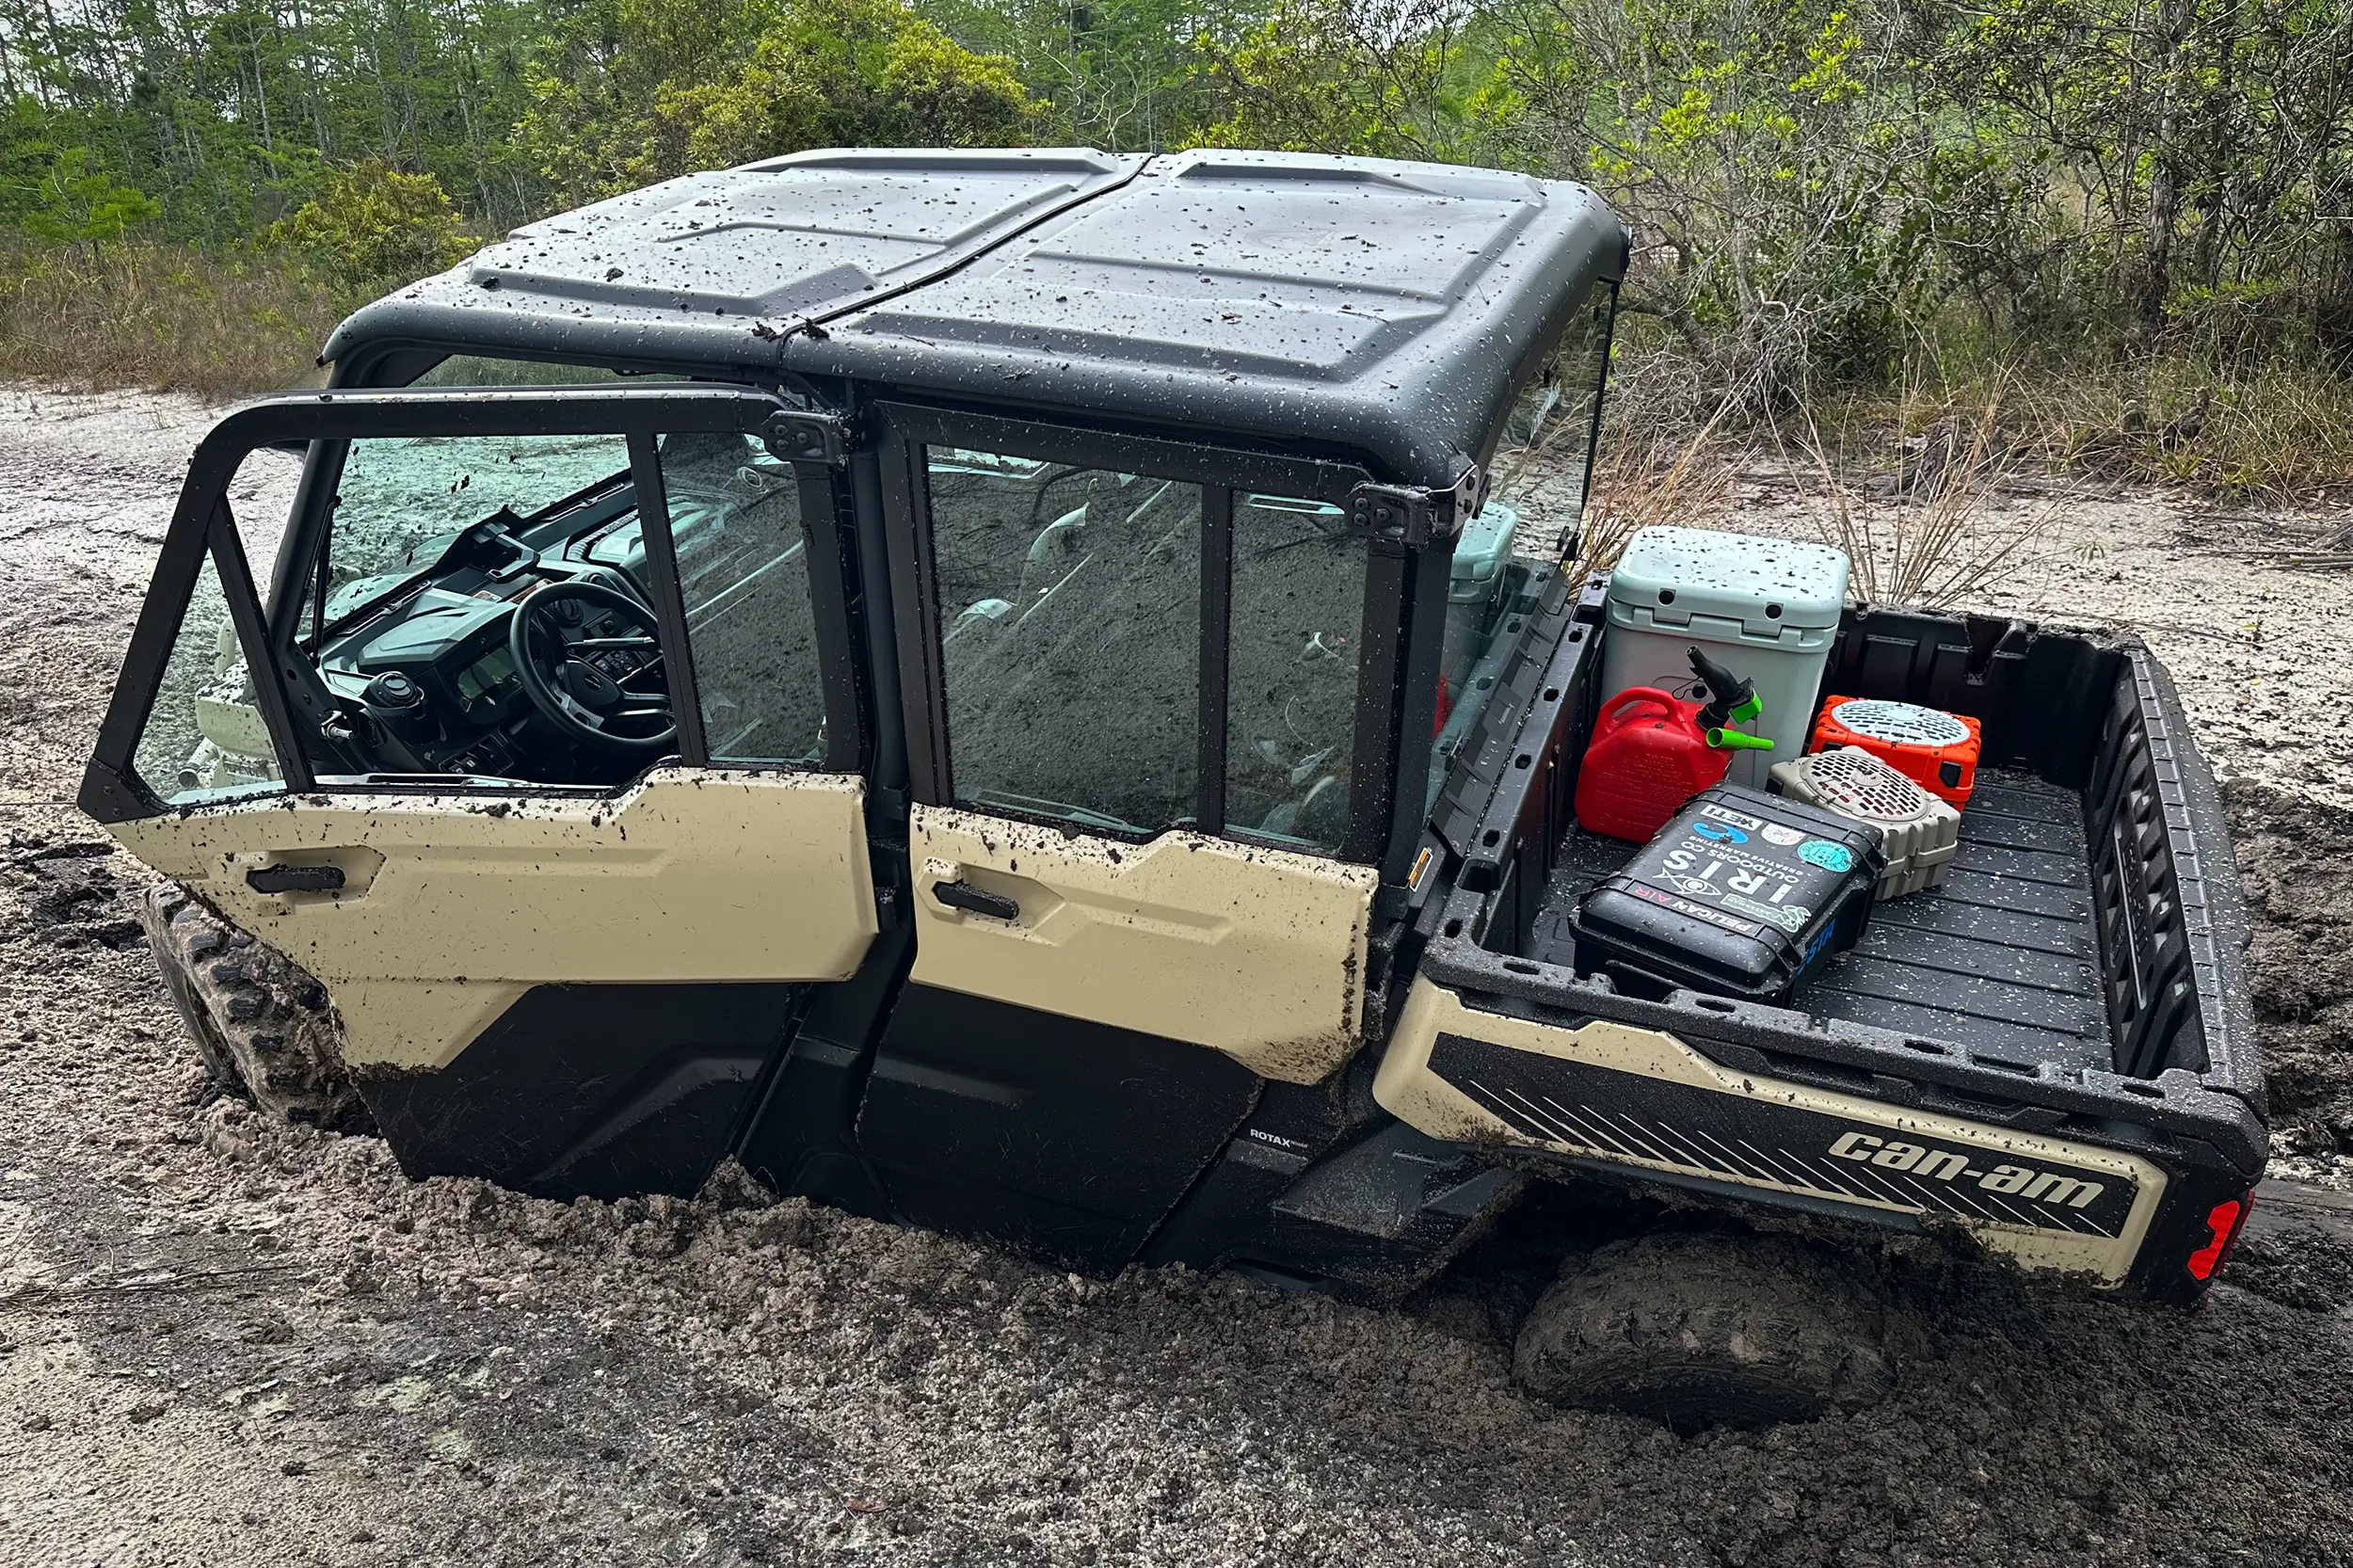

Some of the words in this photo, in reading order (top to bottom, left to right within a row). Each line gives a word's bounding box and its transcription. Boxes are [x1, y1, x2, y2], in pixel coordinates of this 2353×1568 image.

[1707, 808, 1754, 827] YETI
[1680, 840, 1705, 856] CO
[1689, 835, 1748, 857] MARKETING
[1706, 849, 1800, 884] OUTDOORS
[1751, 855, 1804, 876] CREATIVE
[1662, 849, 1792, 904] IRIS
[1633, 886, 1673, 904] AIR
[1672, 901, 1753, 933] PELICAN
[1250, 1128, 1290, 1148] ROTAX
[1828, 1130, 2105, 1209] can-am
